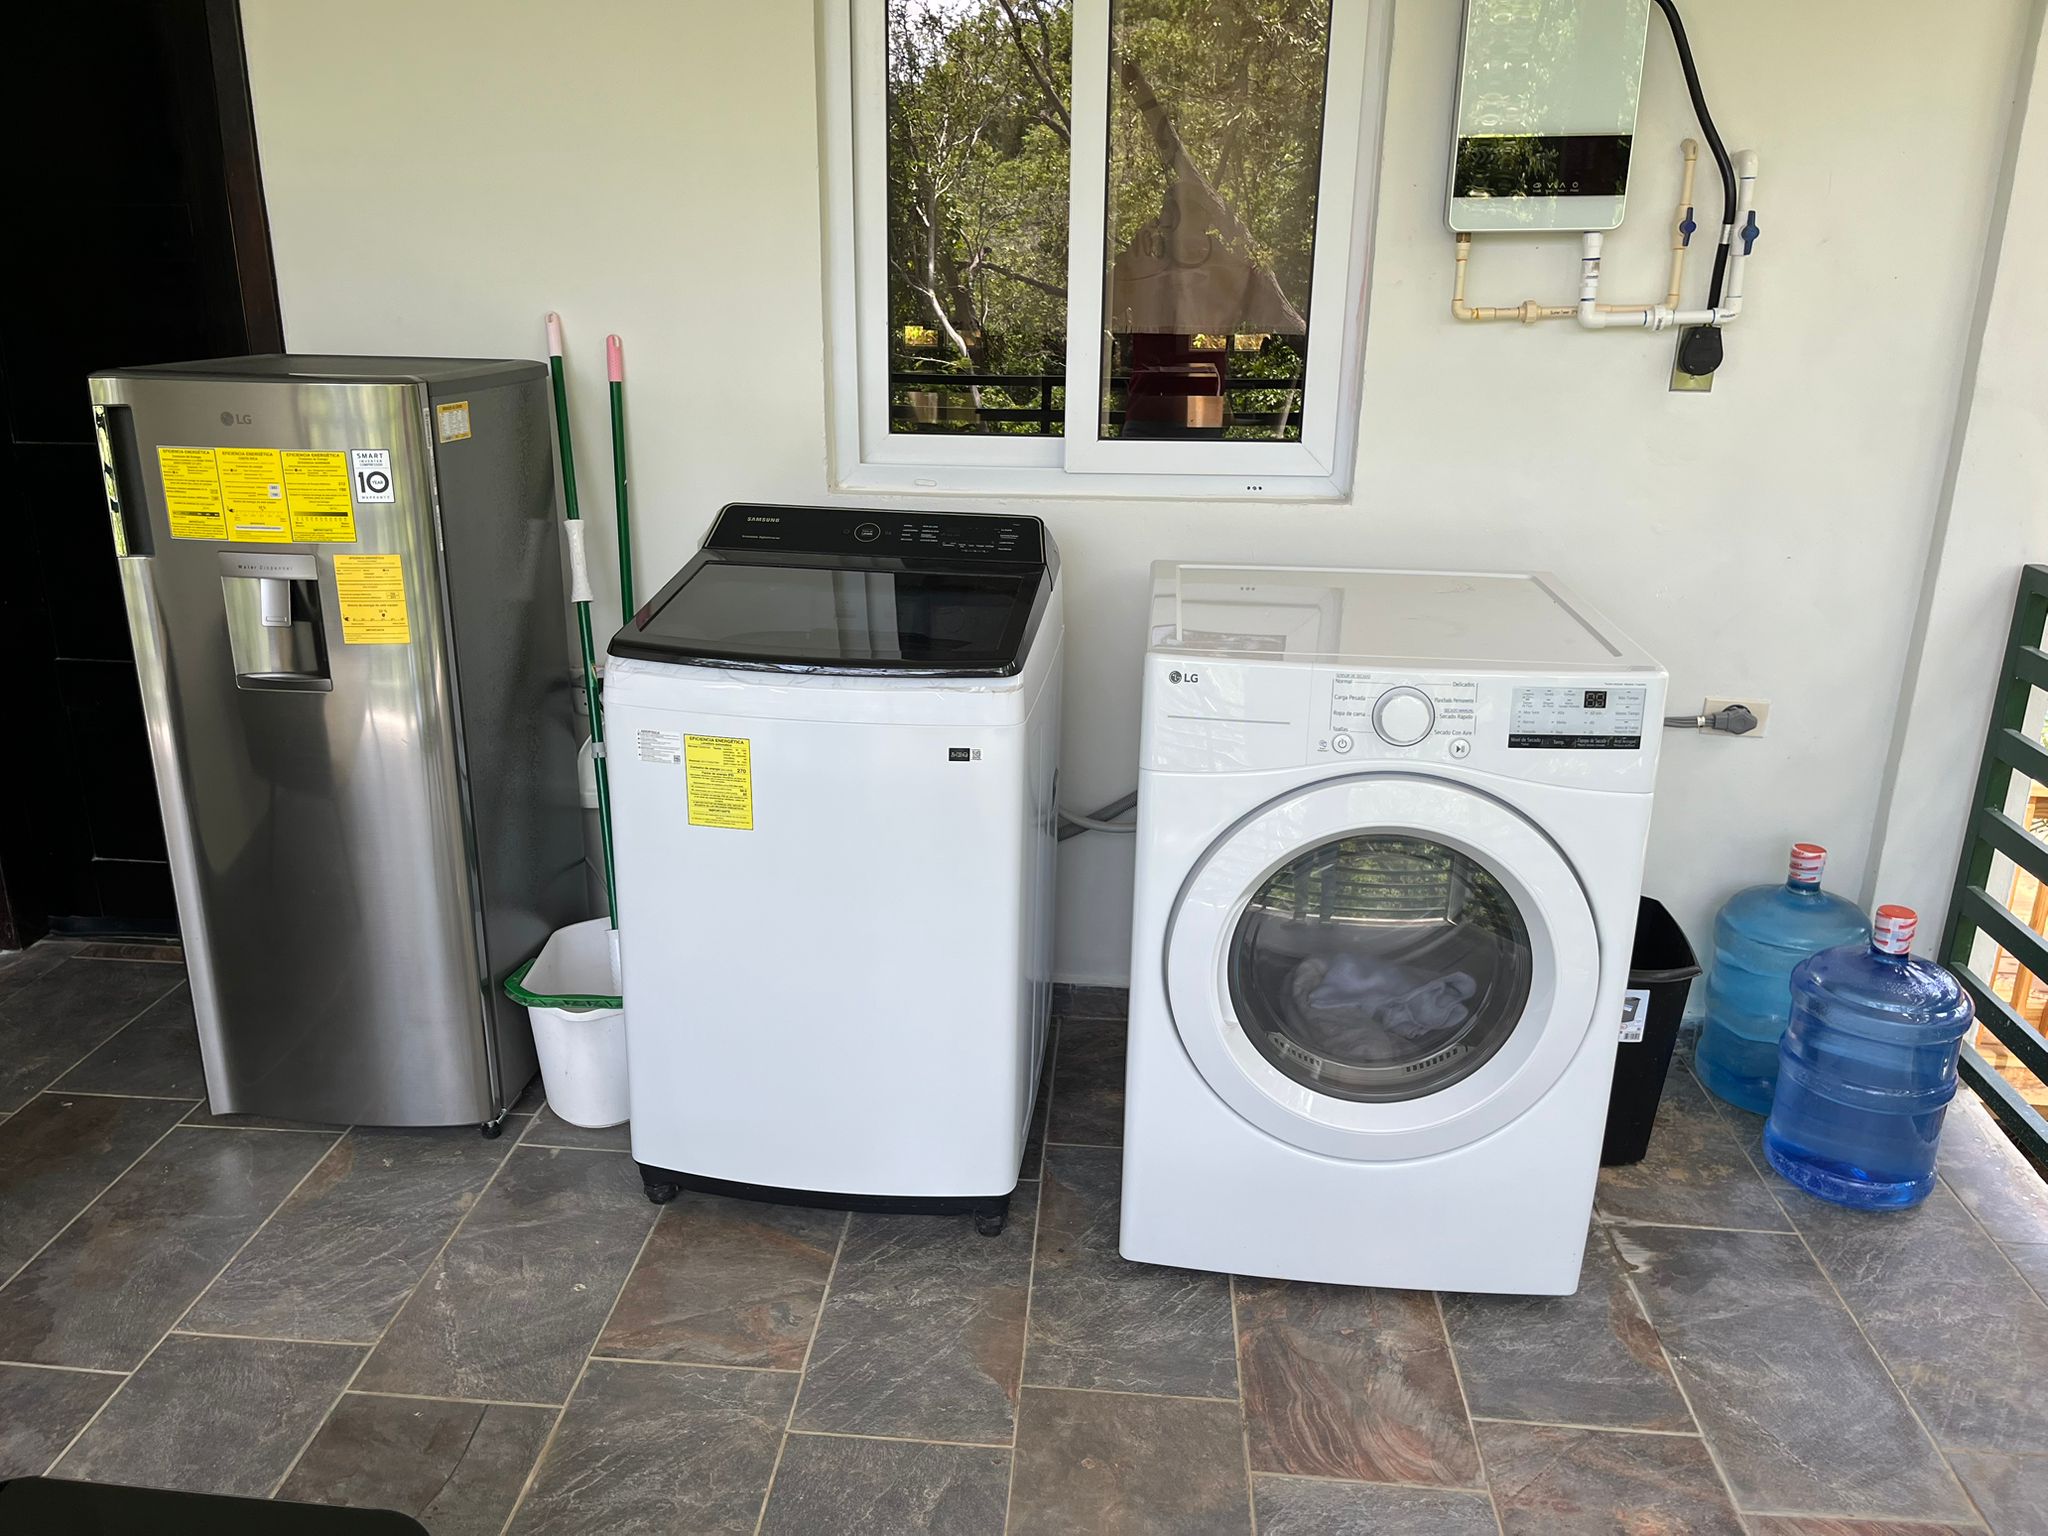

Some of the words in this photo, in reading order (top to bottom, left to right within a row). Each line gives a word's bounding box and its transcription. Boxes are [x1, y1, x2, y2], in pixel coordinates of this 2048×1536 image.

[236, 414, 252, 425] LG
[358, 471, 390, 494] 10
[1184, 673, 1199, 683] LG
[1334, 694, 1348, 702] Carga
